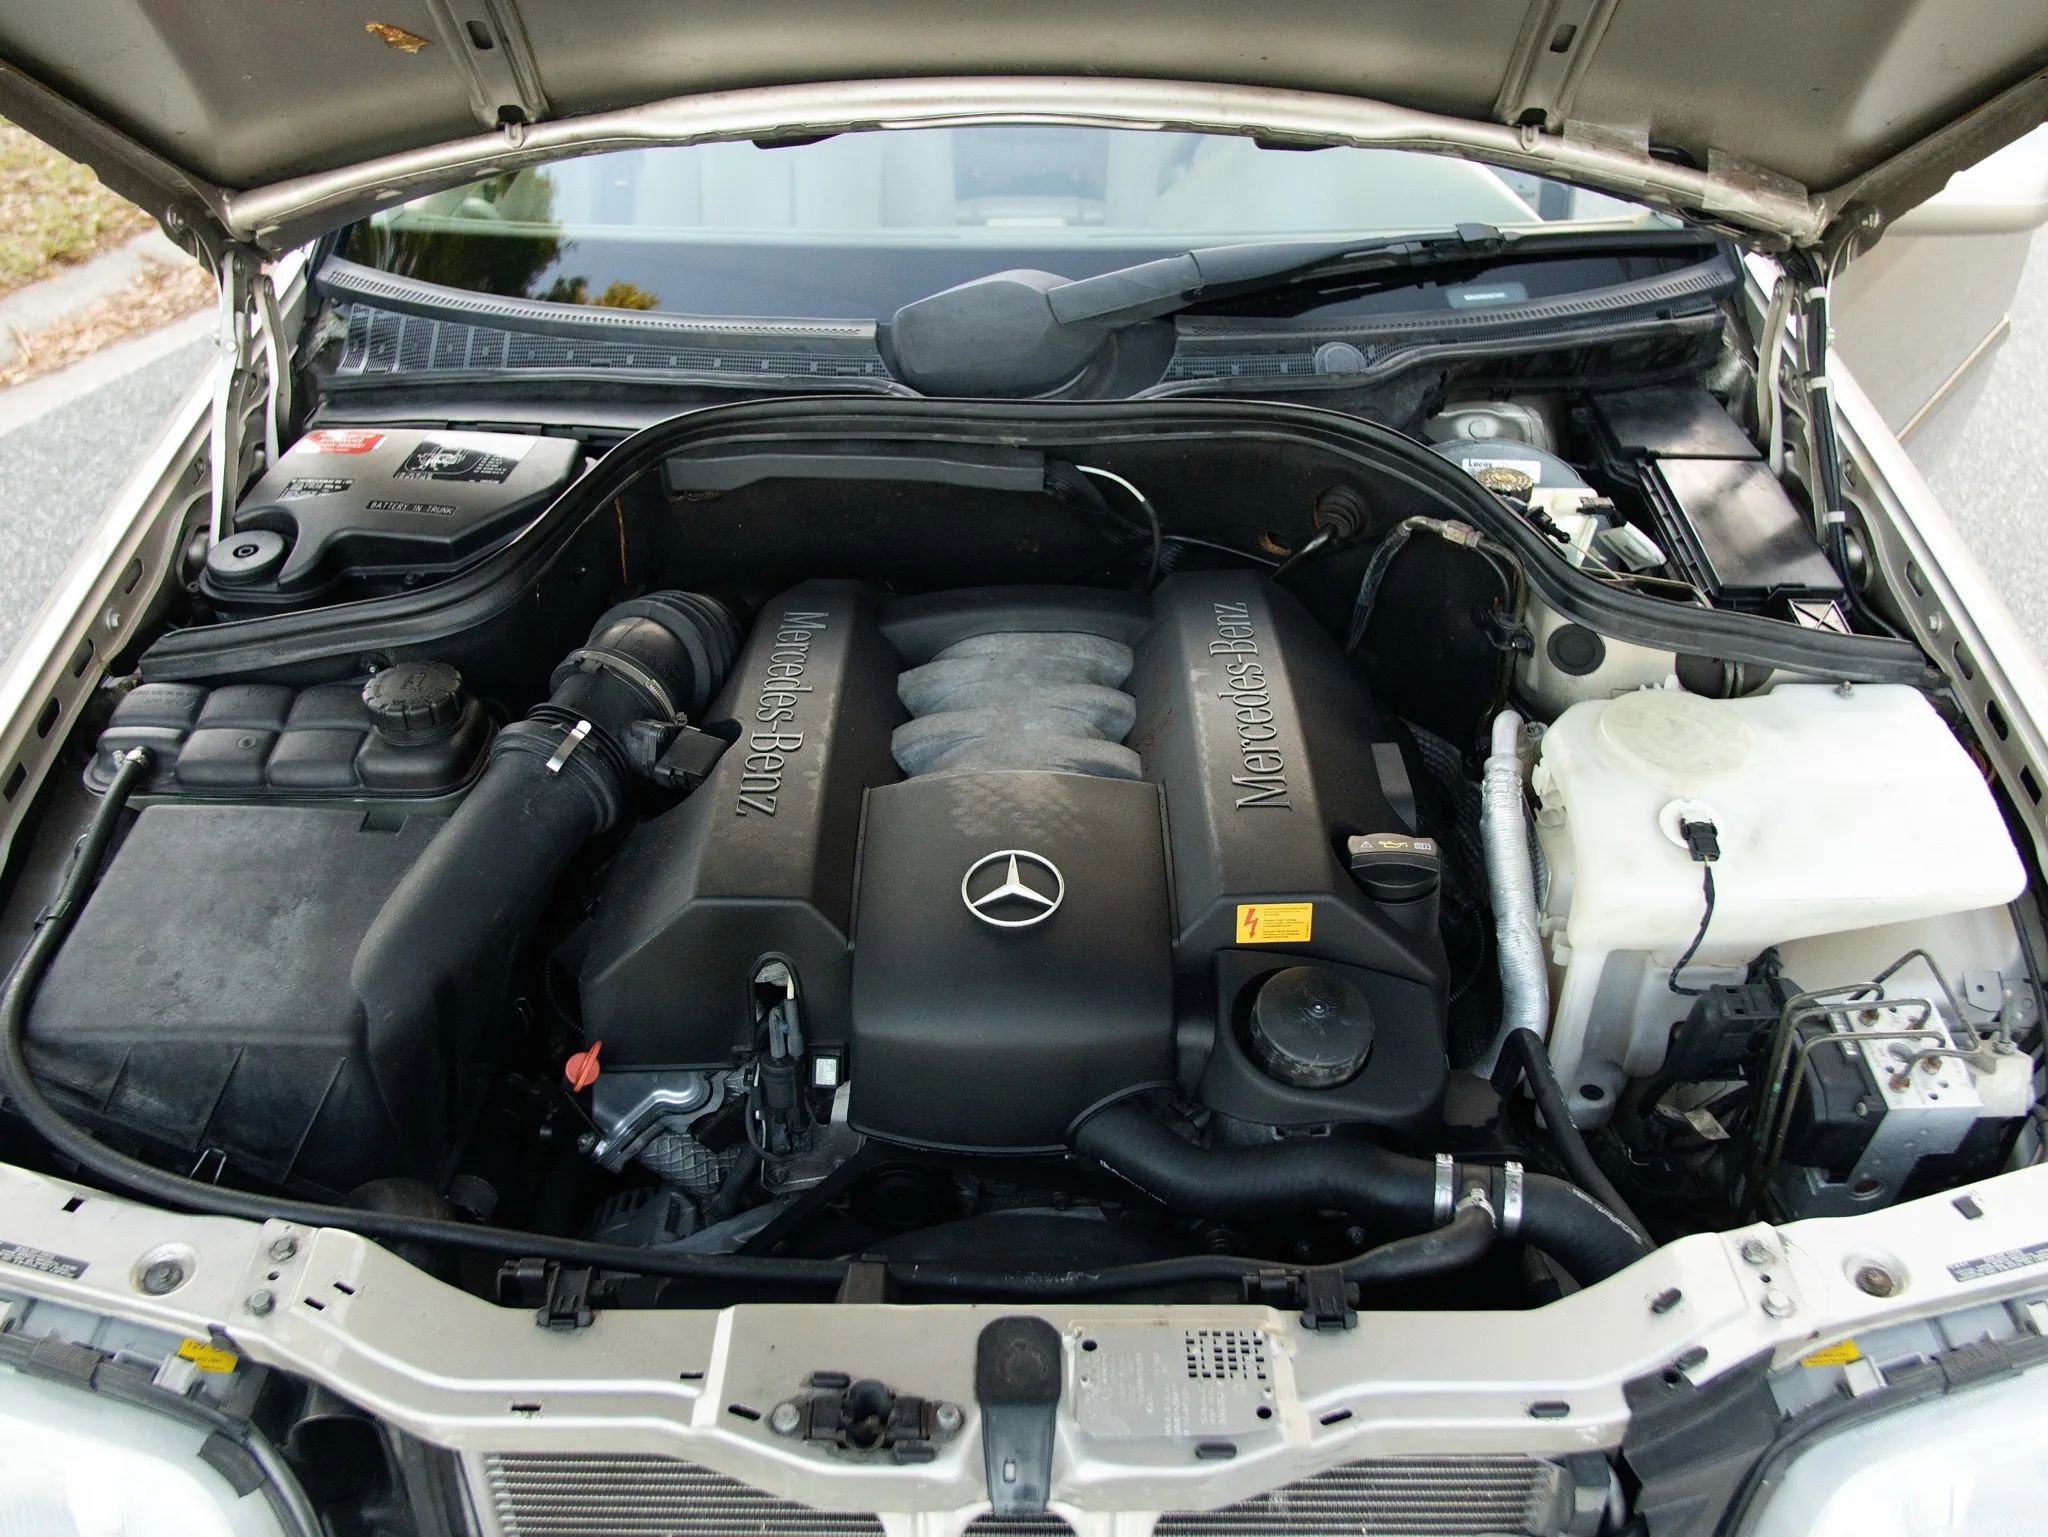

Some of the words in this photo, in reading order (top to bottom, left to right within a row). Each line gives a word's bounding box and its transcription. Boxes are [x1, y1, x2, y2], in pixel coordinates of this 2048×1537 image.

[370, 501, 408, 510] BATTERY
[412, 504, 424, 512] IN
[426, 505, 455, 514] TRUNK
[735, 611, 830, 817] Mercedes-Benz
[1208, 601, 1292, 811] Mercedes-Benz
